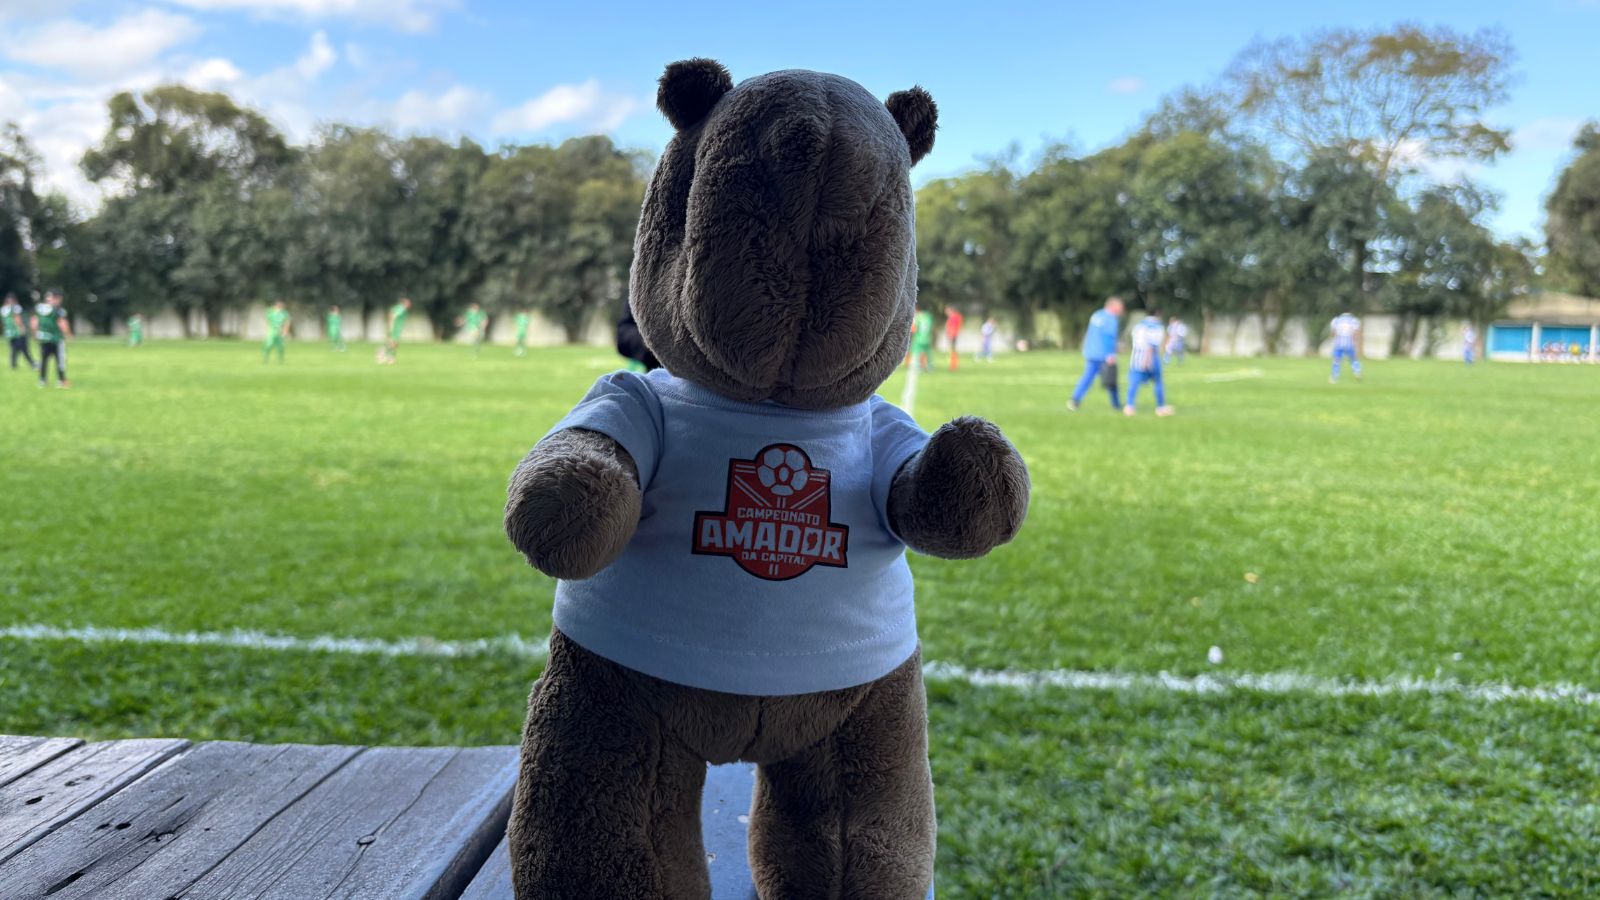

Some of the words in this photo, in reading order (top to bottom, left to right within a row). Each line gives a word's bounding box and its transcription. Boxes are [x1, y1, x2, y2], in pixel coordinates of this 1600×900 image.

[737, 507, 820, 525] CAMPEONATO
[701, 519, 842, 560] AMADOR
[741, 551, 757, 561] DA
[761, 552, 806, 565] CAPITAL
